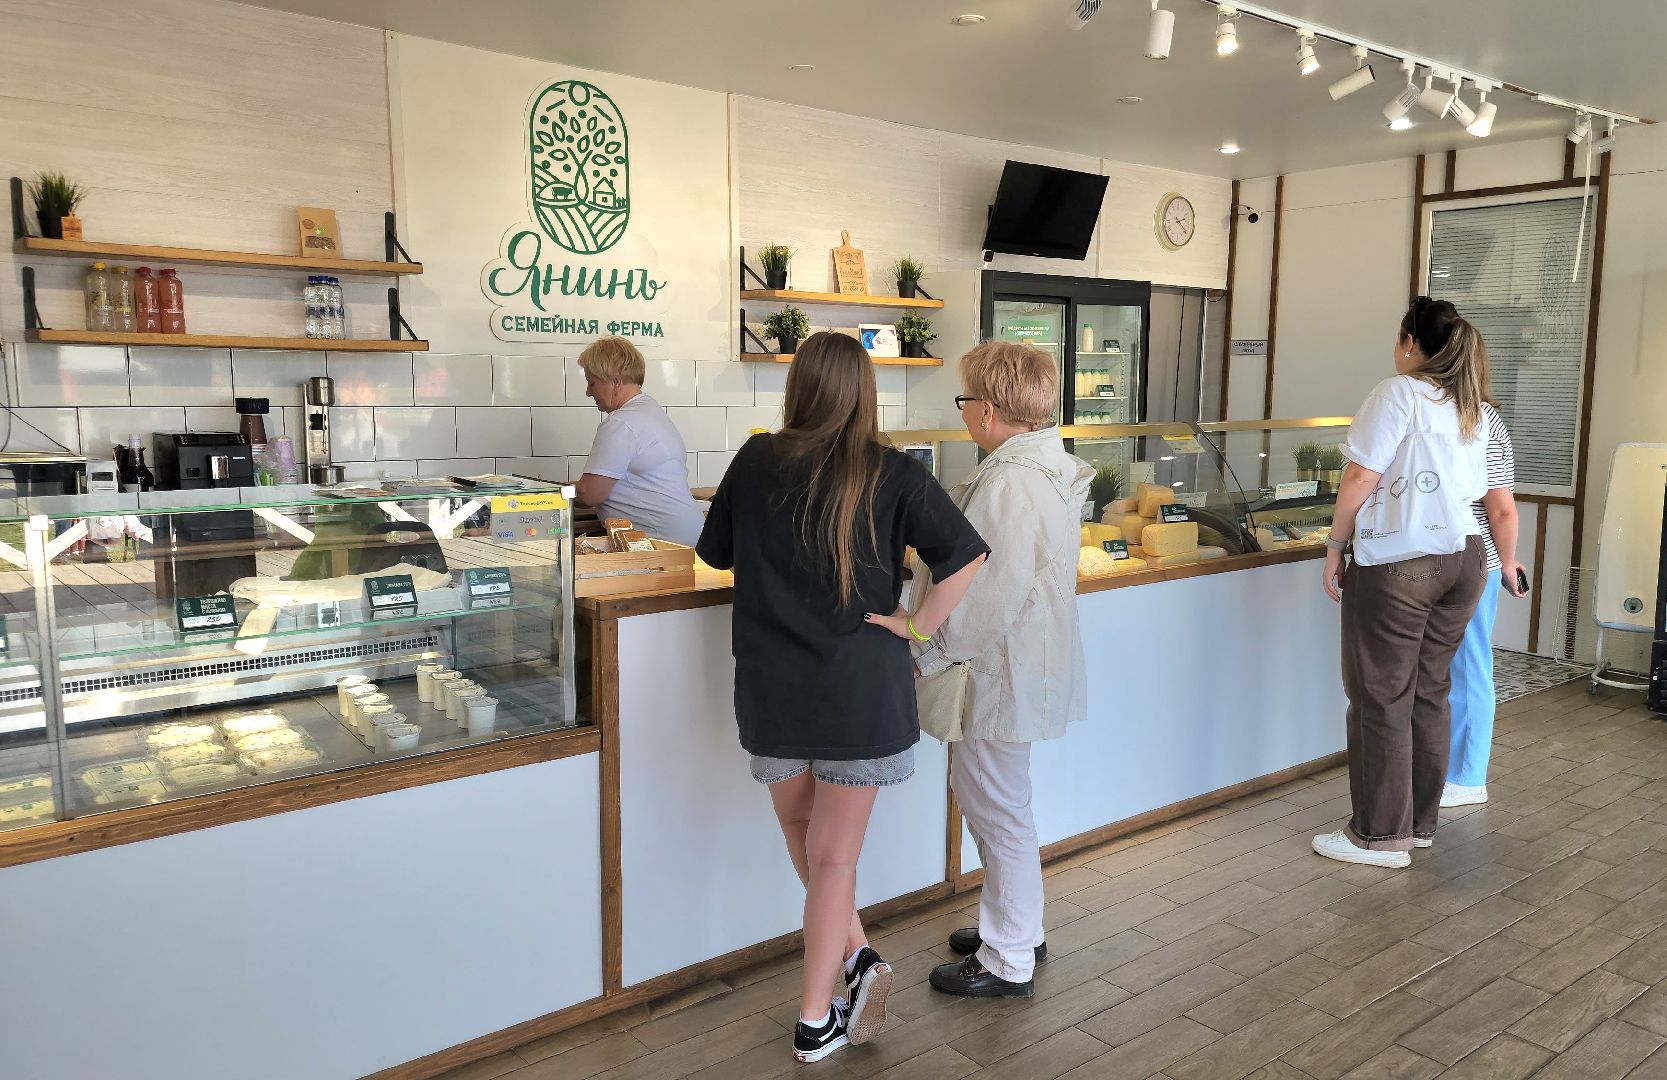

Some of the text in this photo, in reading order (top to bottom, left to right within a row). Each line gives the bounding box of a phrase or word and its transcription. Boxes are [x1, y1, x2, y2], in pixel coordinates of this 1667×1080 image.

[488, 230, 668, 312] Янинъ
[501, 314, 664, 337] СЕМЕЙНАЯ ФЕРМА
